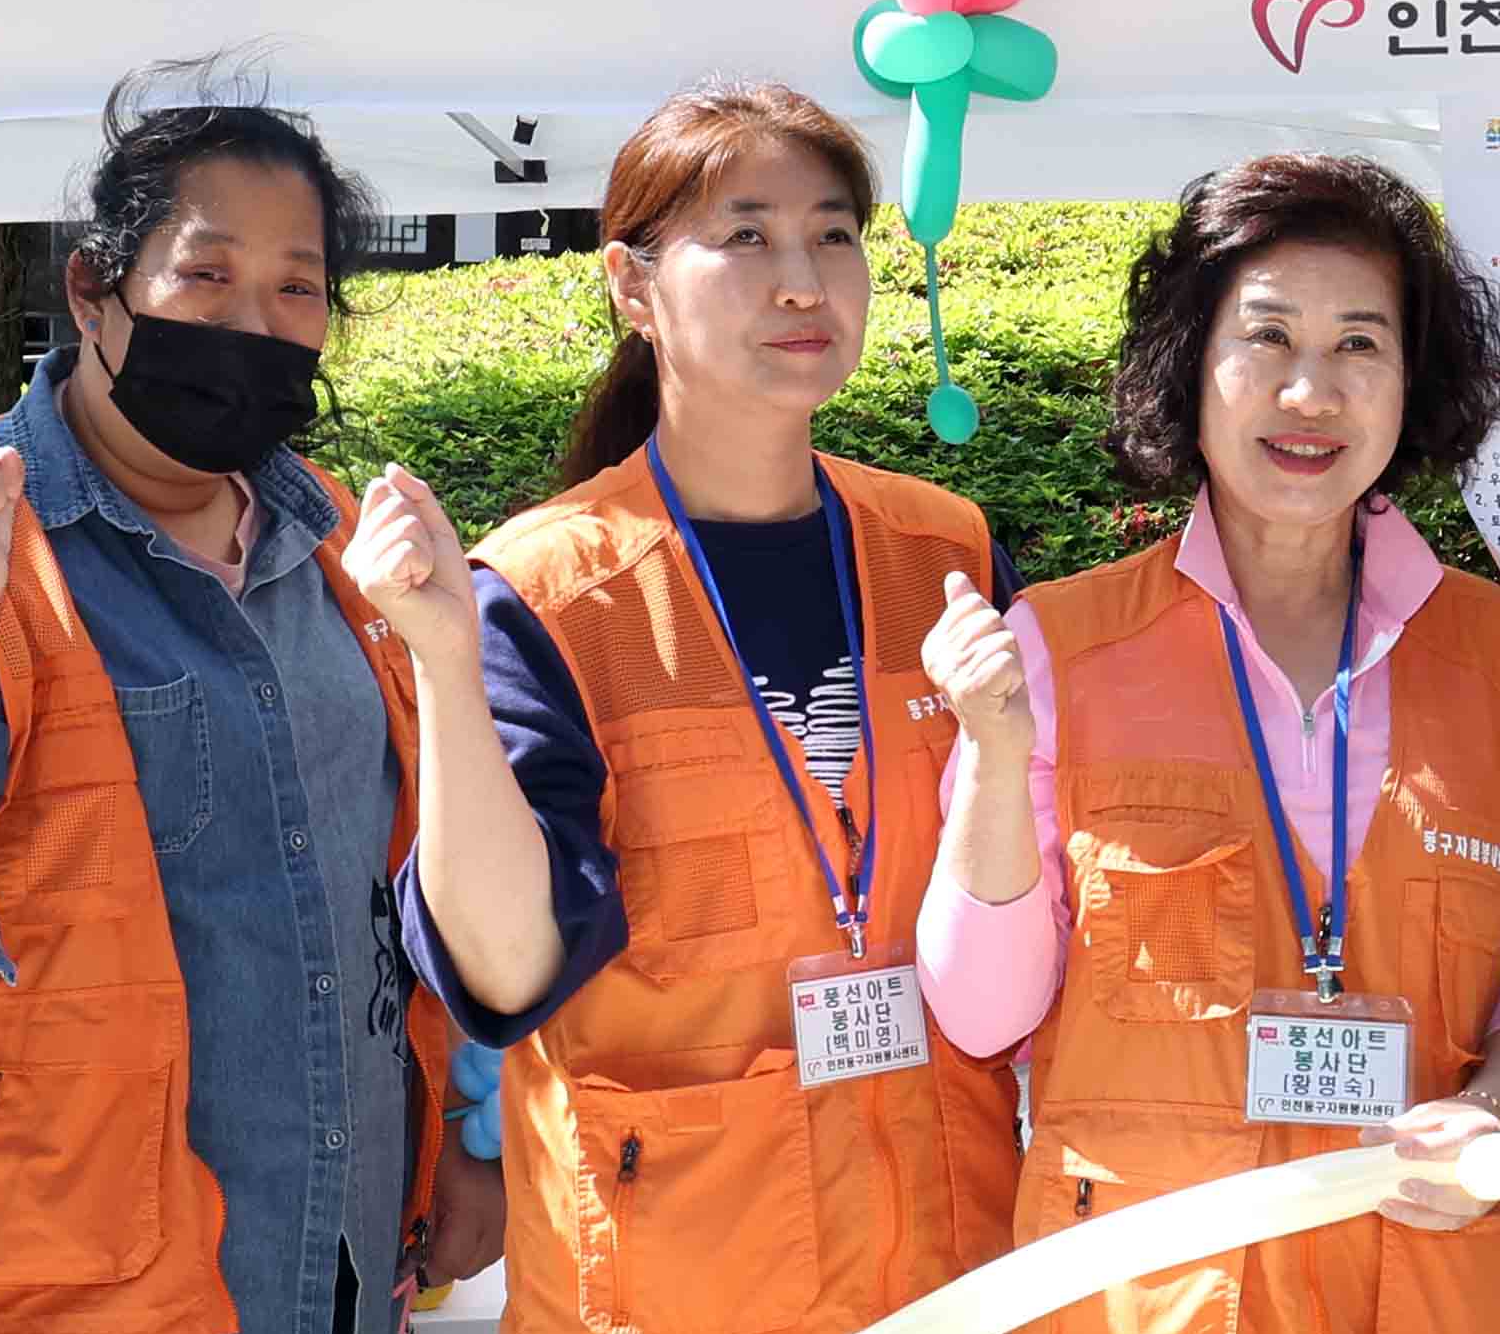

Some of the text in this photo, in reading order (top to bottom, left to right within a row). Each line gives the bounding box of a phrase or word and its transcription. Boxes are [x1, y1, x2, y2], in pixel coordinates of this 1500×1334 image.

[823, 976, 904, 1010] 풍선아트
[831, 1002, 892, 1032] 봉사단
[1288, 1024, 1387, 1051] 풍선아트
[1293, 1050, 1368, 1075] 봉사단
